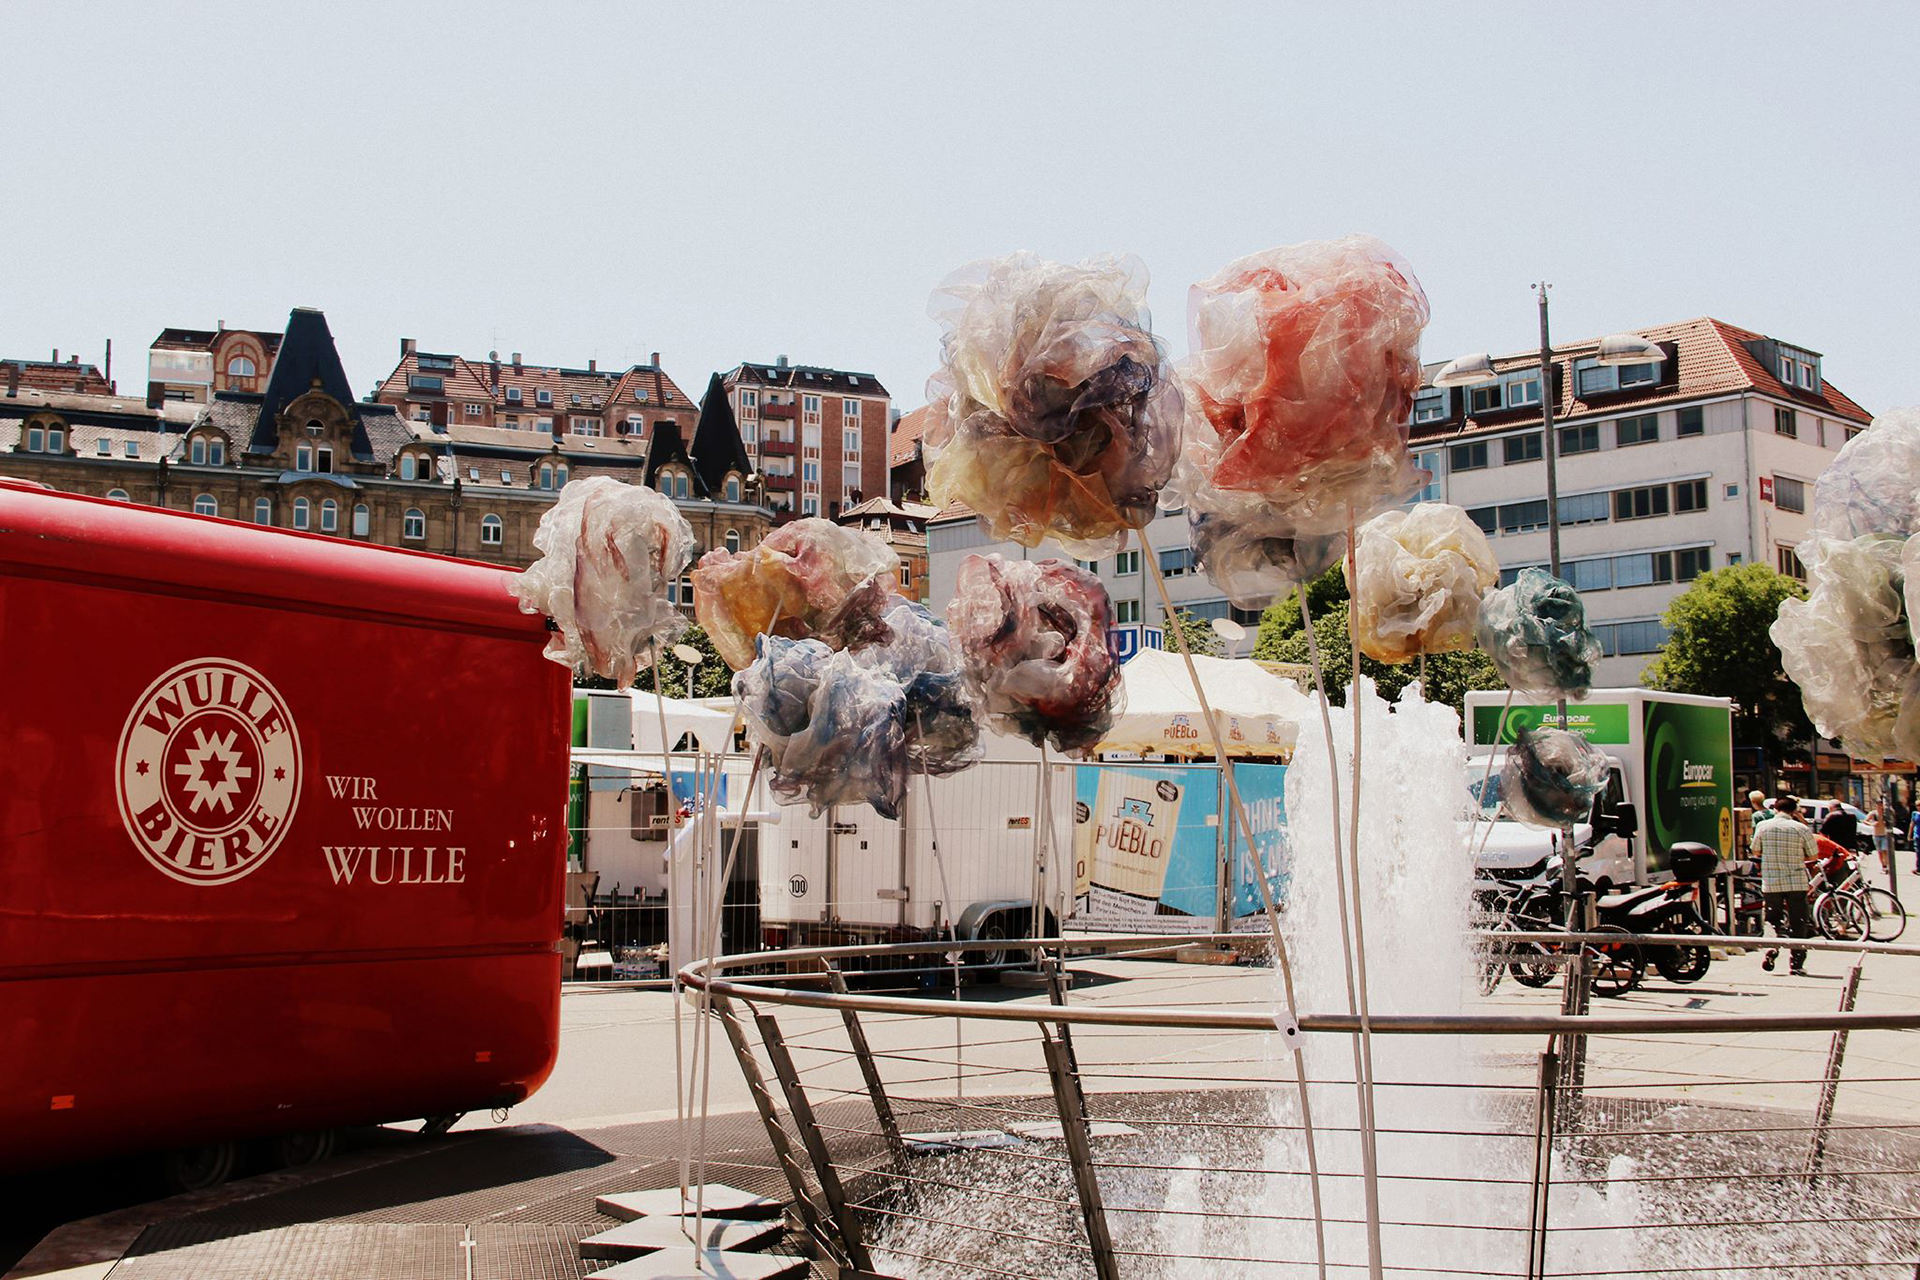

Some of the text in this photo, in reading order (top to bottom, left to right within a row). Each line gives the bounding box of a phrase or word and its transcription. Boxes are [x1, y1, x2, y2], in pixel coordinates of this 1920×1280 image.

[140, 671, 287, 744] WULLE
[1164, 724, 1198, 738] PUEBLO
[1683, 759, 1713, 785] Europcar
[325, 775, 378, 800] WIR
[352, 806, 454, 832] WOLLEN
[135, 799, 280, 871] BIERE
[1096, 820, 1163, 858] PUEBLO
[321, 846, 466, 885] WULLE
[791, 880, 806, 893] 100
